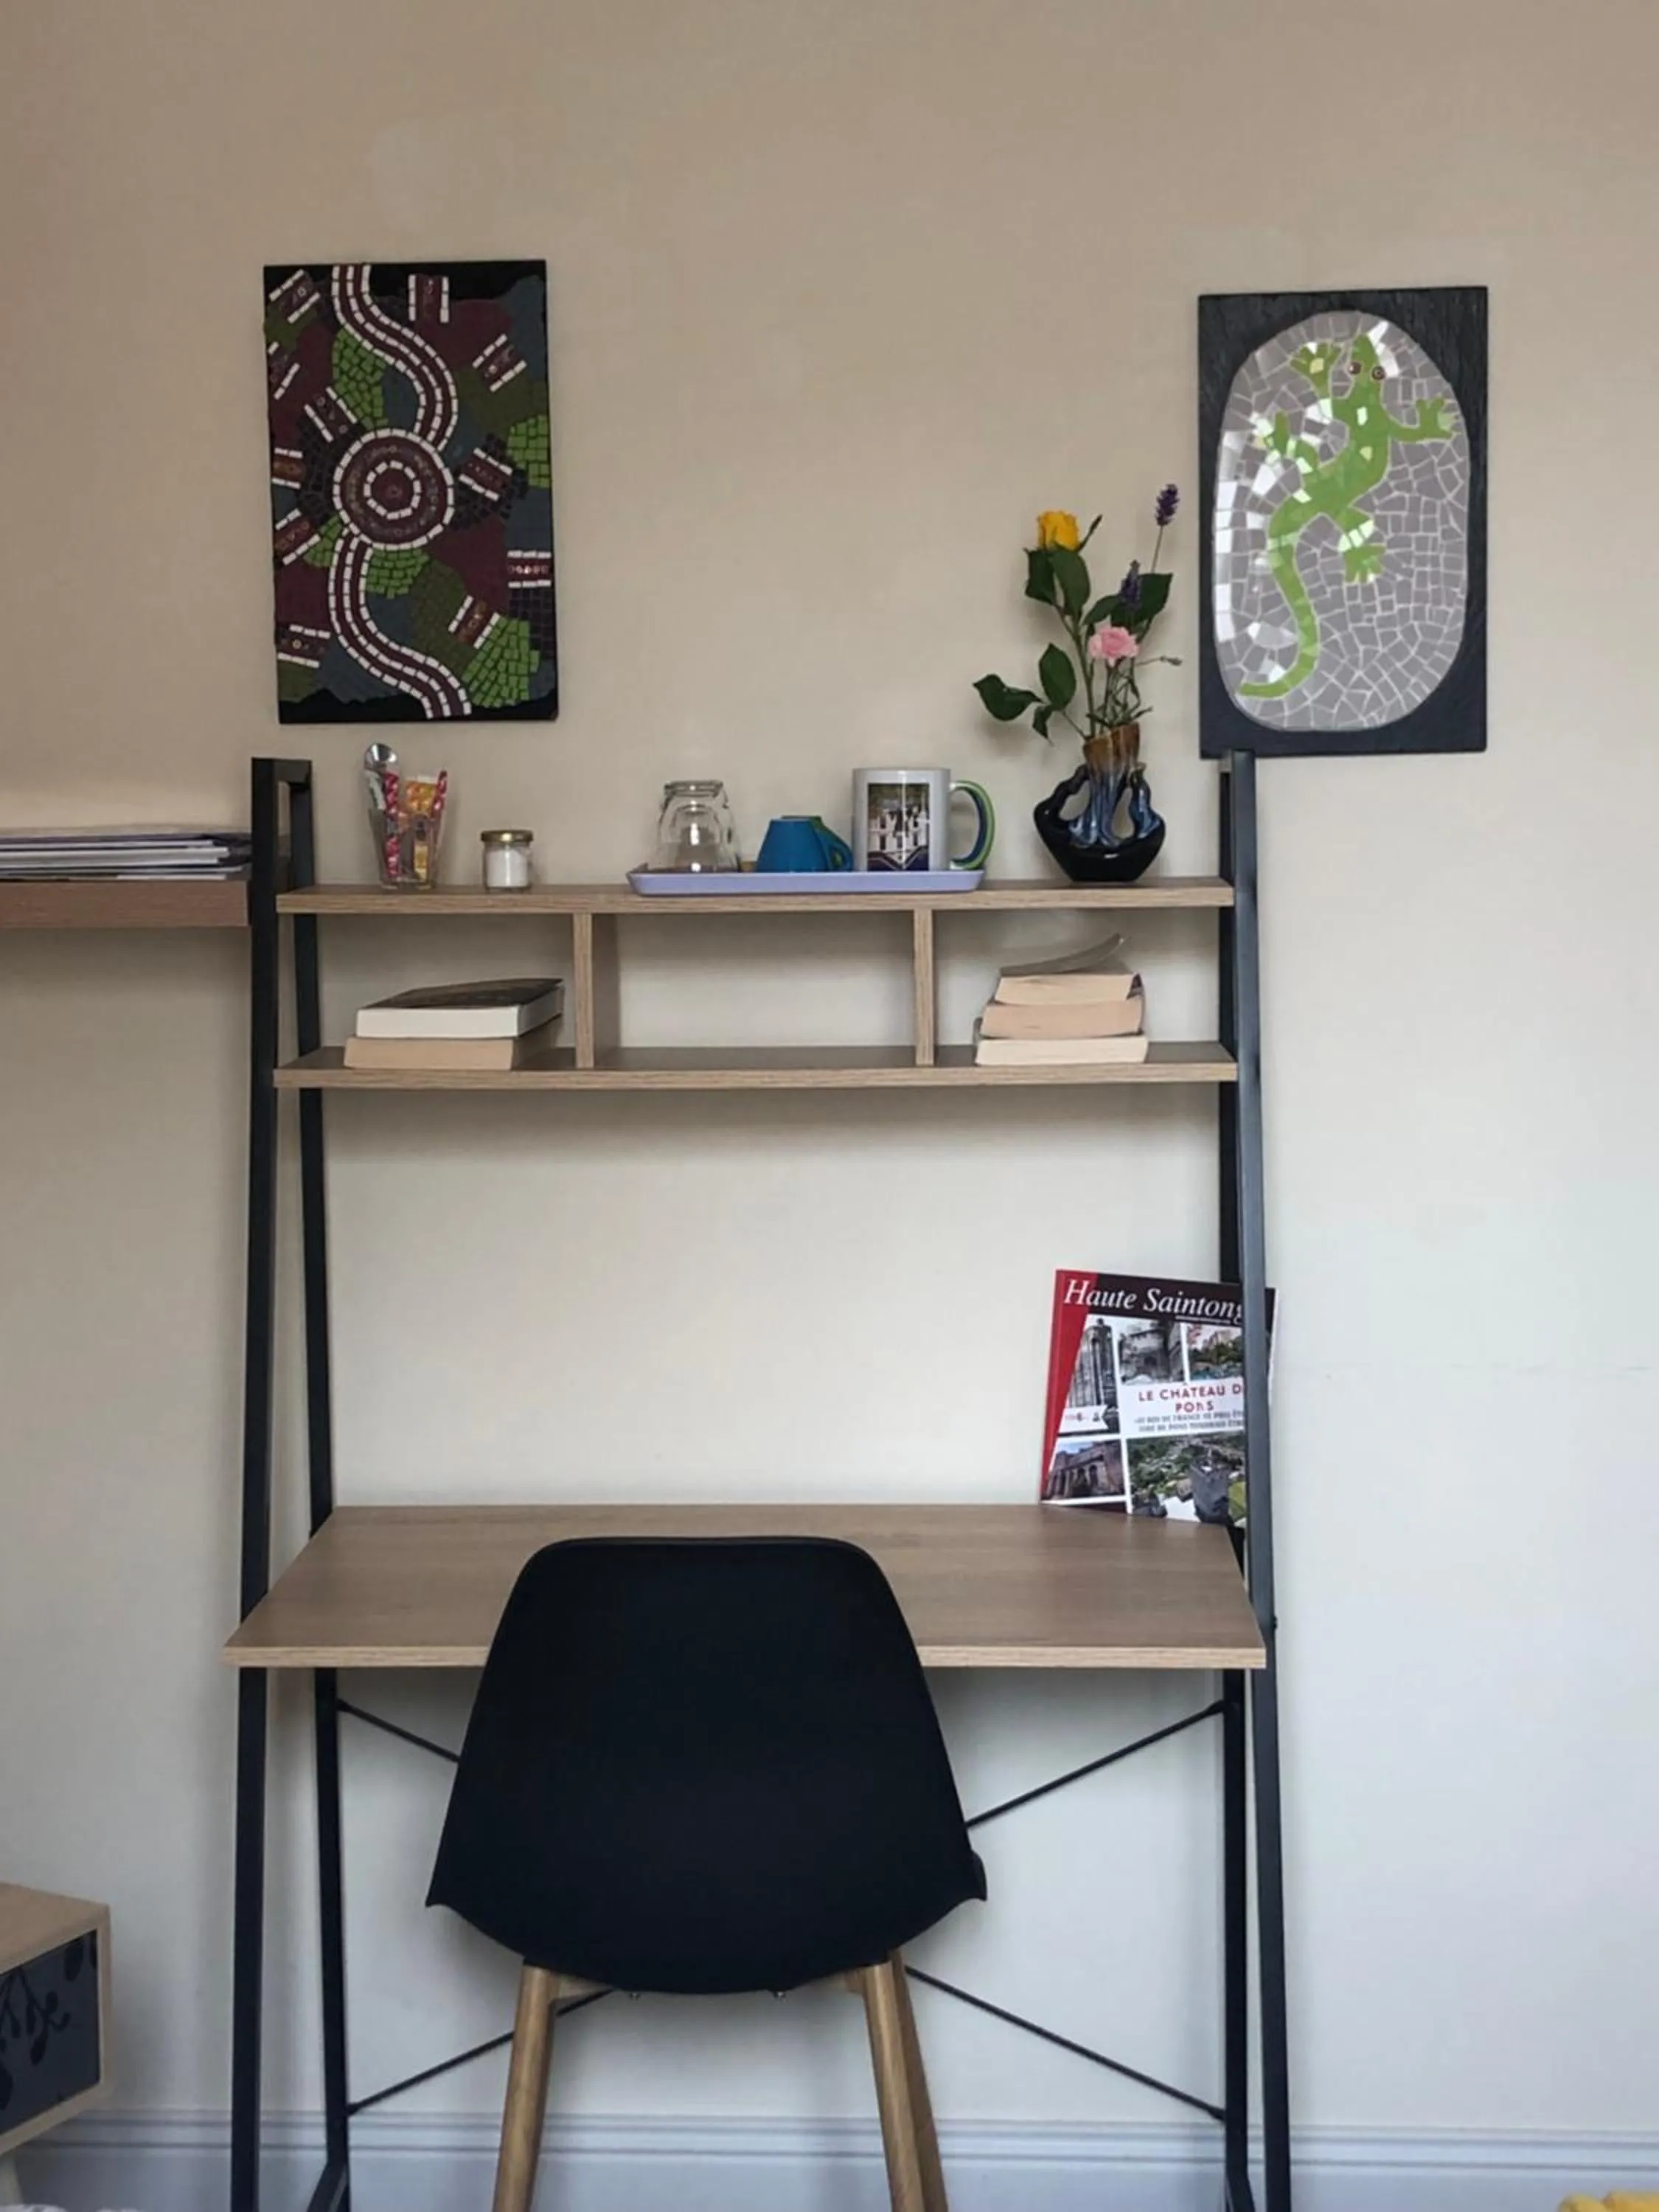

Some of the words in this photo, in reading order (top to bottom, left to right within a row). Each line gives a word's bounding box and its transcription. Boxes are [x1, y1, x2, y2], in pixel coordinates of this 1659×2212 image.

[1063, 1279, 1138, 1310] Haute
[1143, 1287, 1242, 1325] Saintong
[1138, 1391, 1153, 1402] LE
[1232, 1383, 1242, 1395] D
